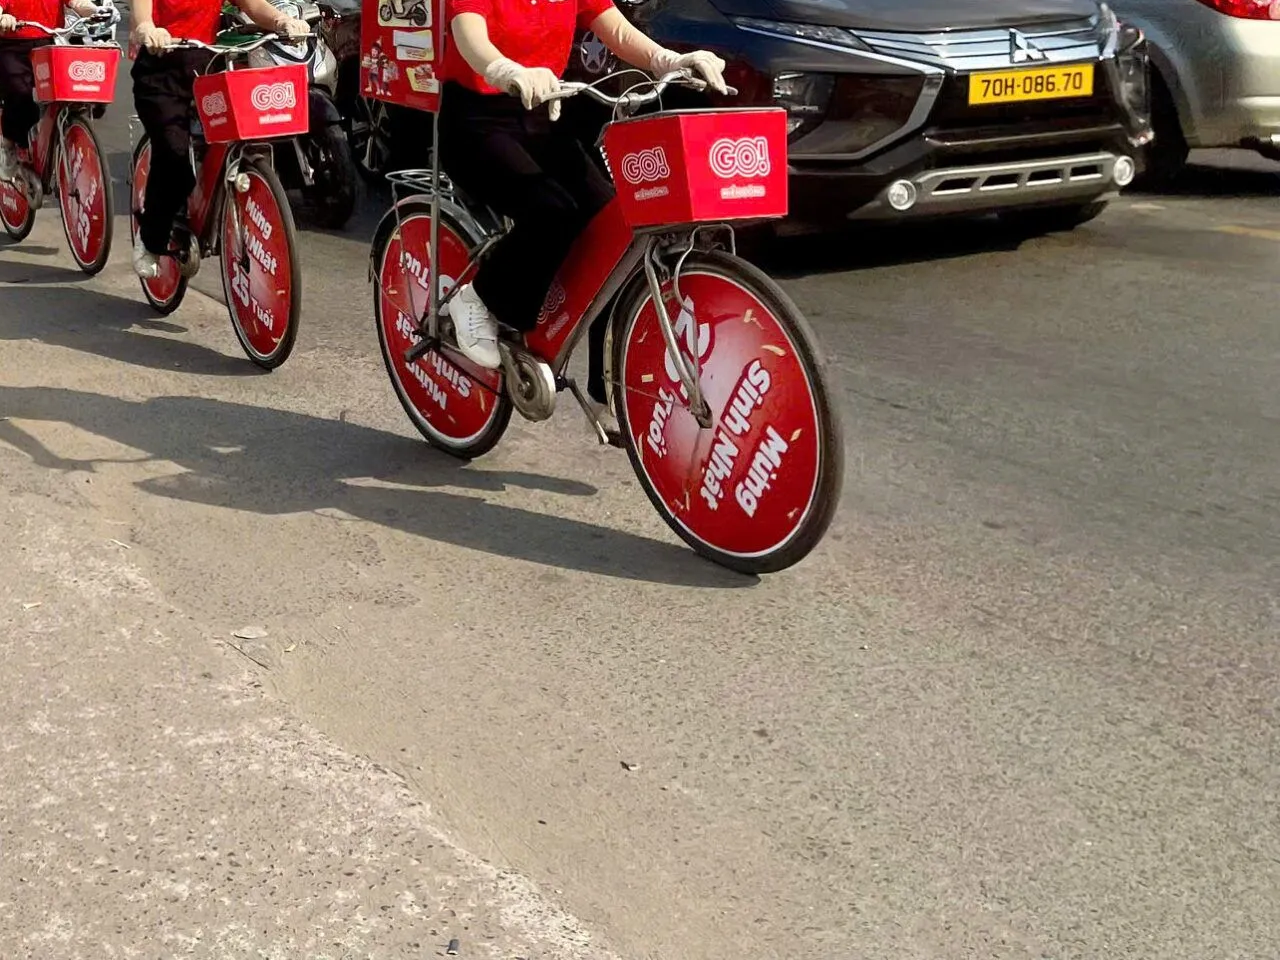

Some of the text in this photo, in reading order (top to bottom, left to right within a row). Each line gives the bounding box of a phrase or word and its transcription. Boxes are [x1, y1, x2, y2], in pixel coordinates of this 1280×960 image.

[251, 81, 297, 110] GO!
[981, 71, 1084, 98] 70H-086.70
[621, 146, 671, 184] GO!
[709, 136, 771, 178] GO!
[700, 359, 772, 512] Sinh Nhật
[735, 425, 789, 519] Mừng
